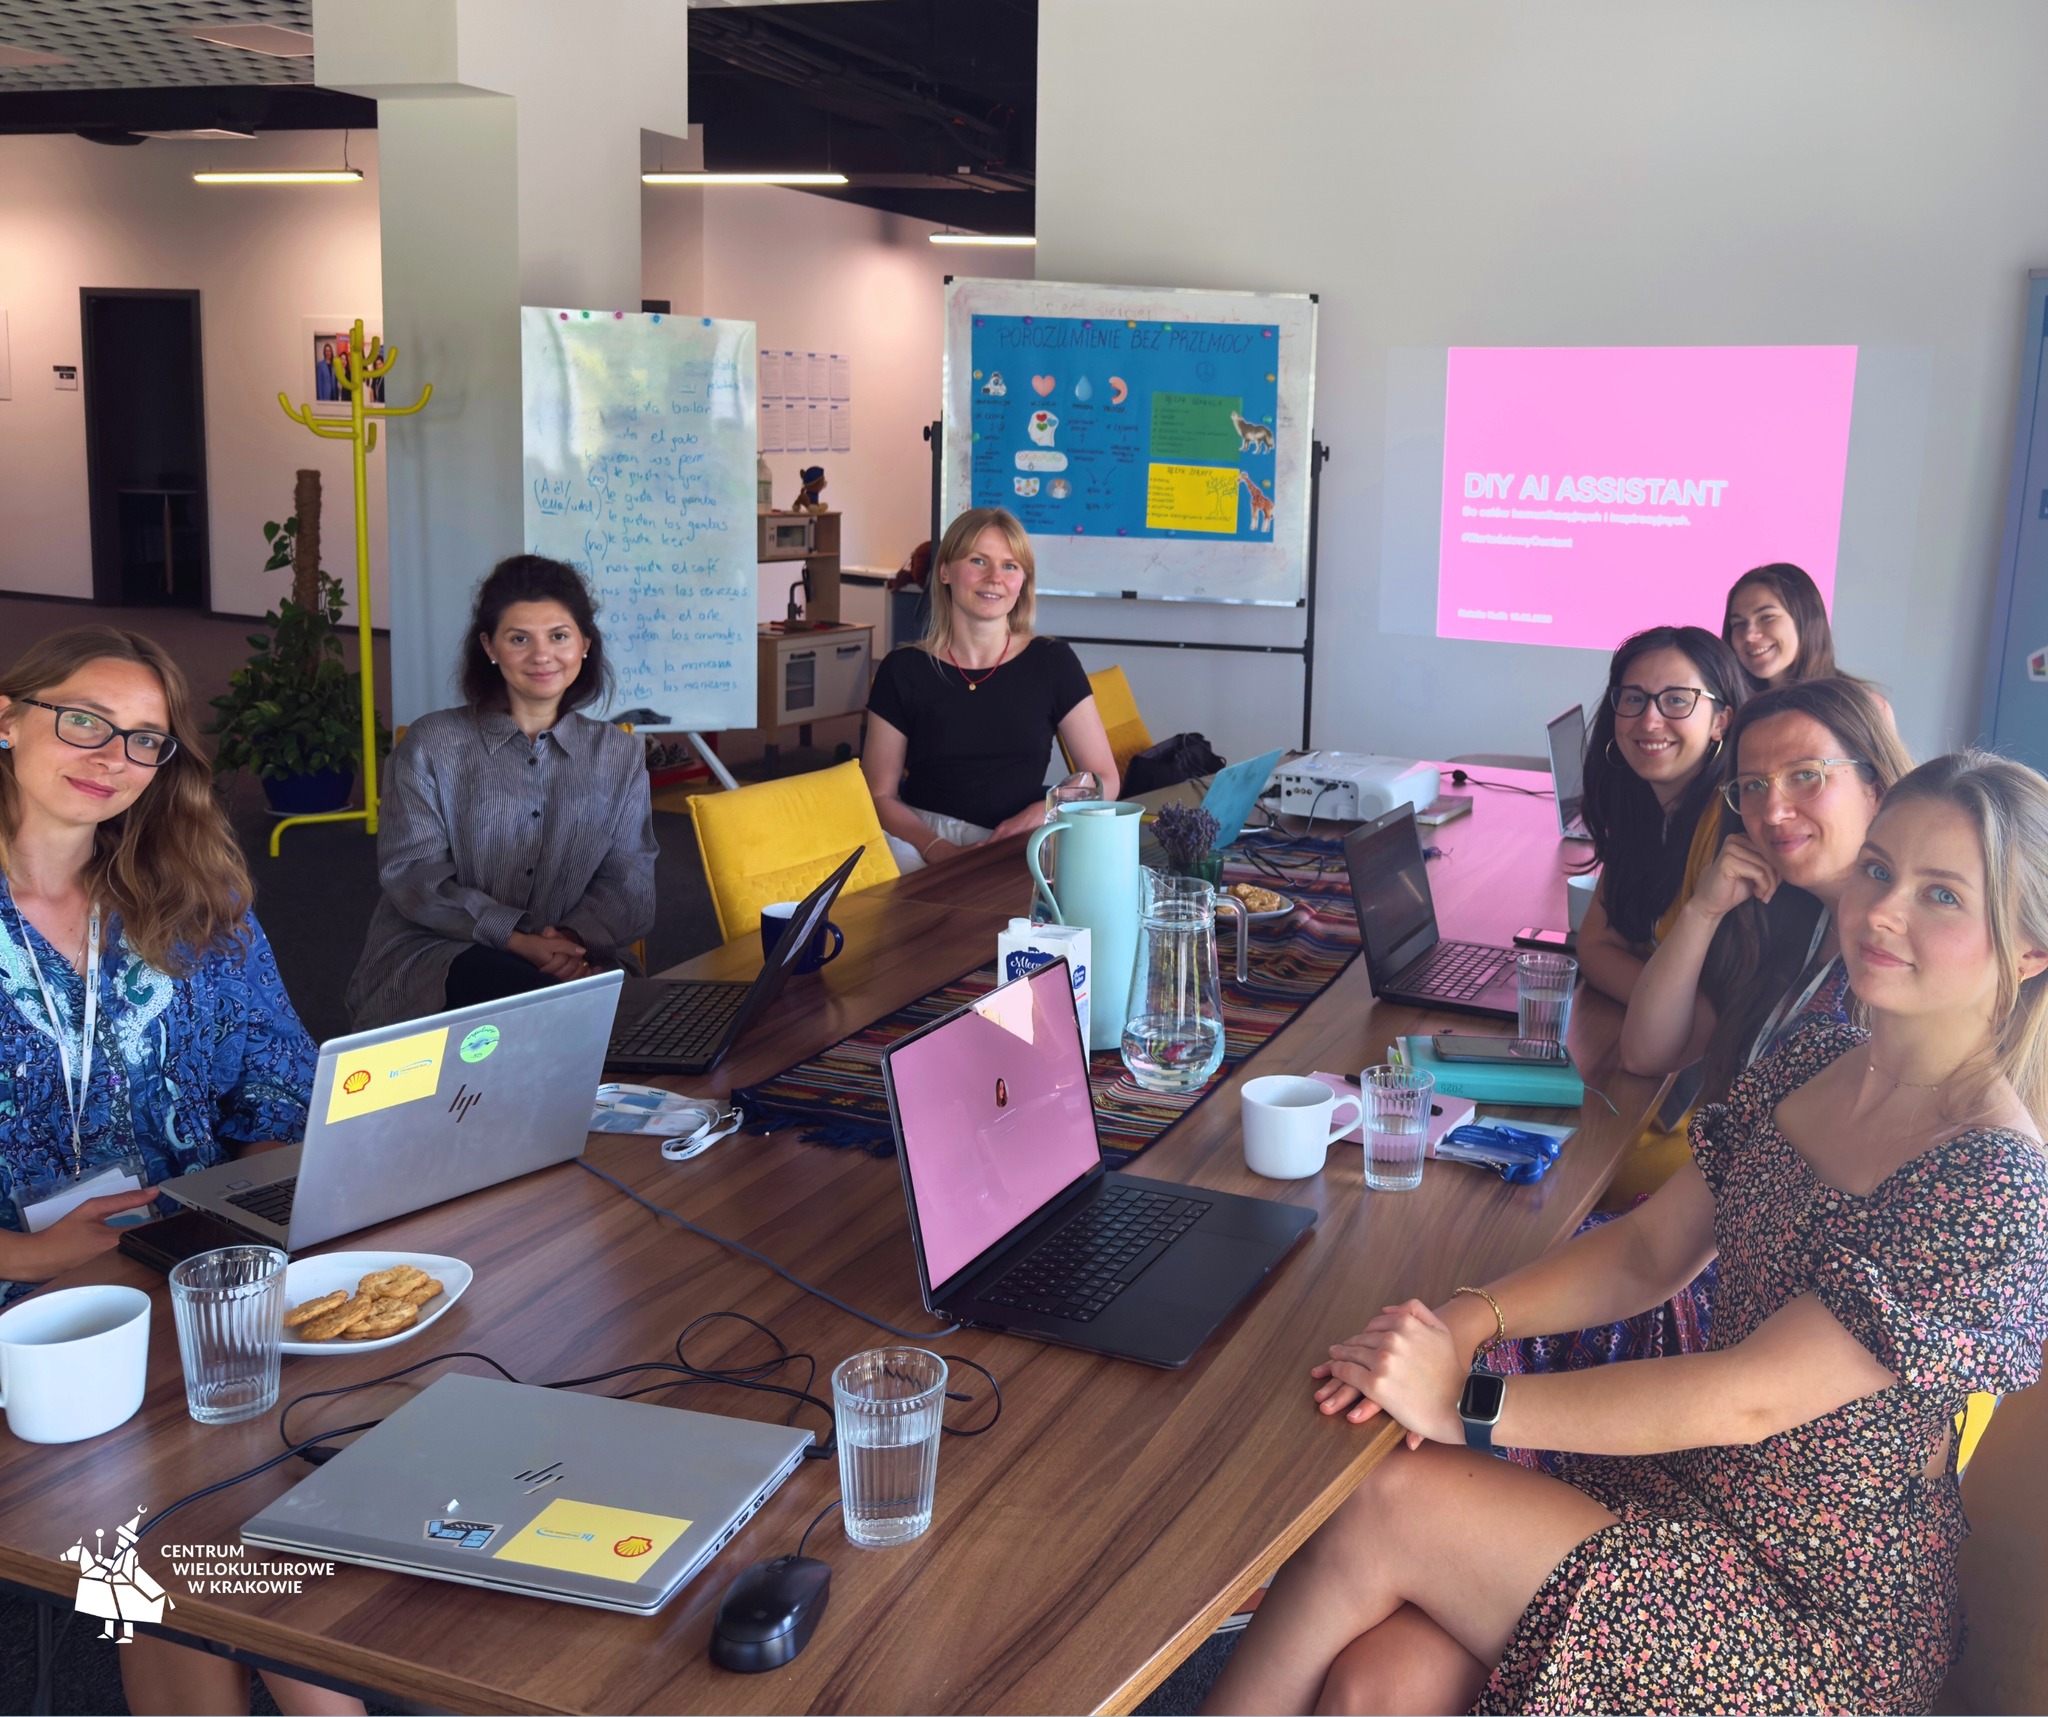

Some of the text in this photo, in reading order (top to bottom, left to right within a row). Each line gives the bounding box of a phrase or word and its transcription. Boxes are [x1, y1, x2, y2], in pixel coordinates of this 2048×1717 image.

[996, 326, 1255, 354] POROZUMIENIE BEZ PRZEMOCY
[650, 428, 667, 444] el
[671, 430, 699, 453] gato
[1464, 472, 1729, 507] DIY AI ASSISTANT
[671, 560, 688, 575] el
[691, 557, 720, 578] café
[678, 608, 692, 622] el
[664, 656, 676, 673] la
[1441, 1083, 1464, 1095] 2025
